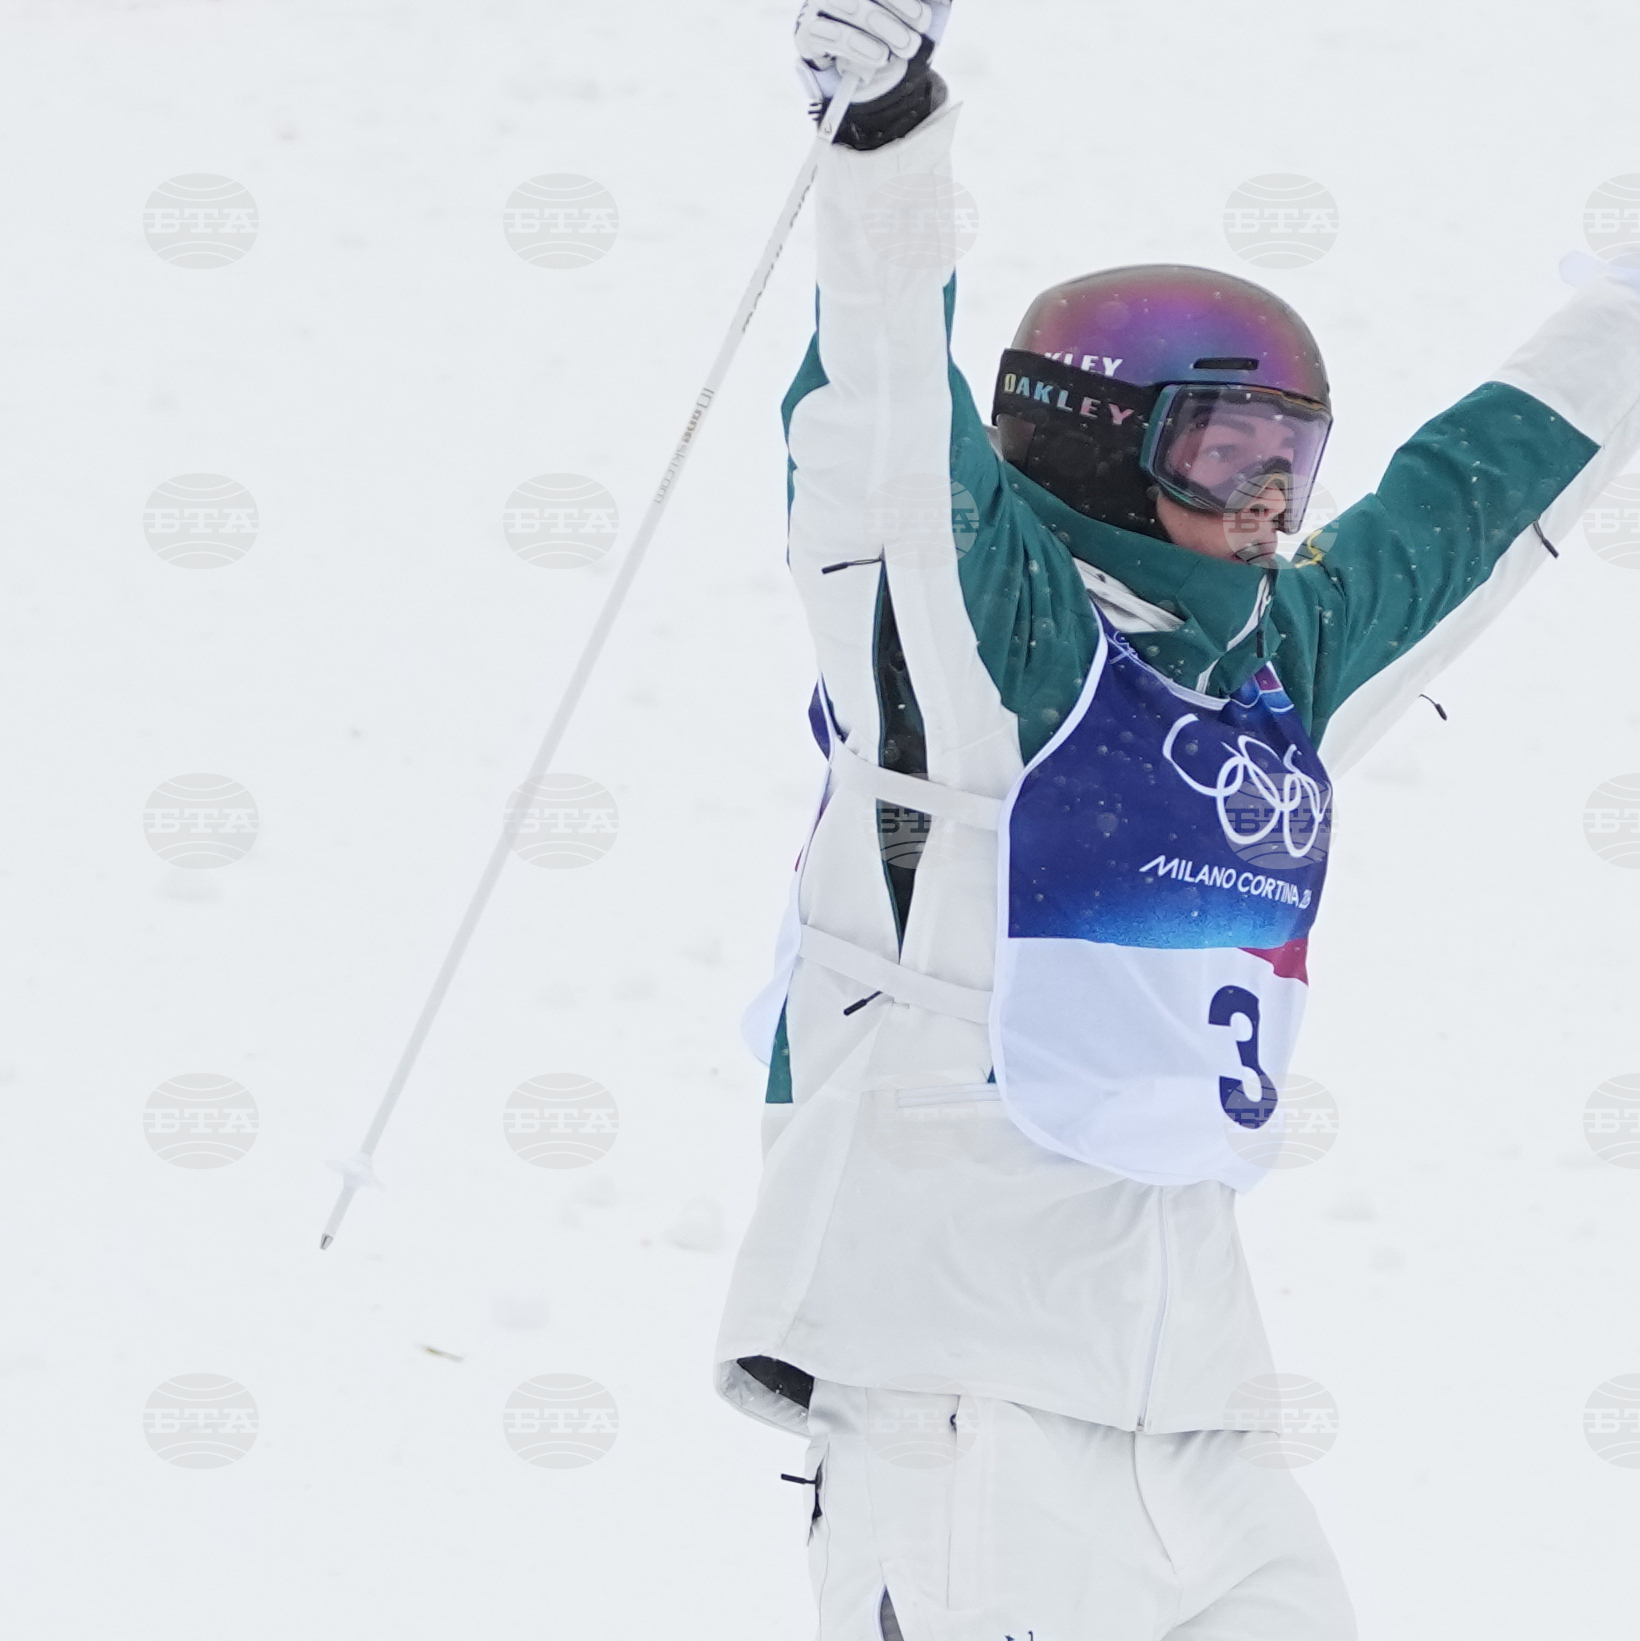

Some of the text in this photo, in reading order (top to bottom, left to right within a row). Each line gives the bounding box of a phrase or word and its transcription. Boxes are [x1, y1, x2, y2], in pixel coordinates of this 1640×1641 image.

[1004, 373, 1135, 426] OAKLEY
[1138, 854, 1237, 890] MILANO
[1237, 871, 1300, 908] CORTINA
[1208, 984, 1279, 1130] 3
